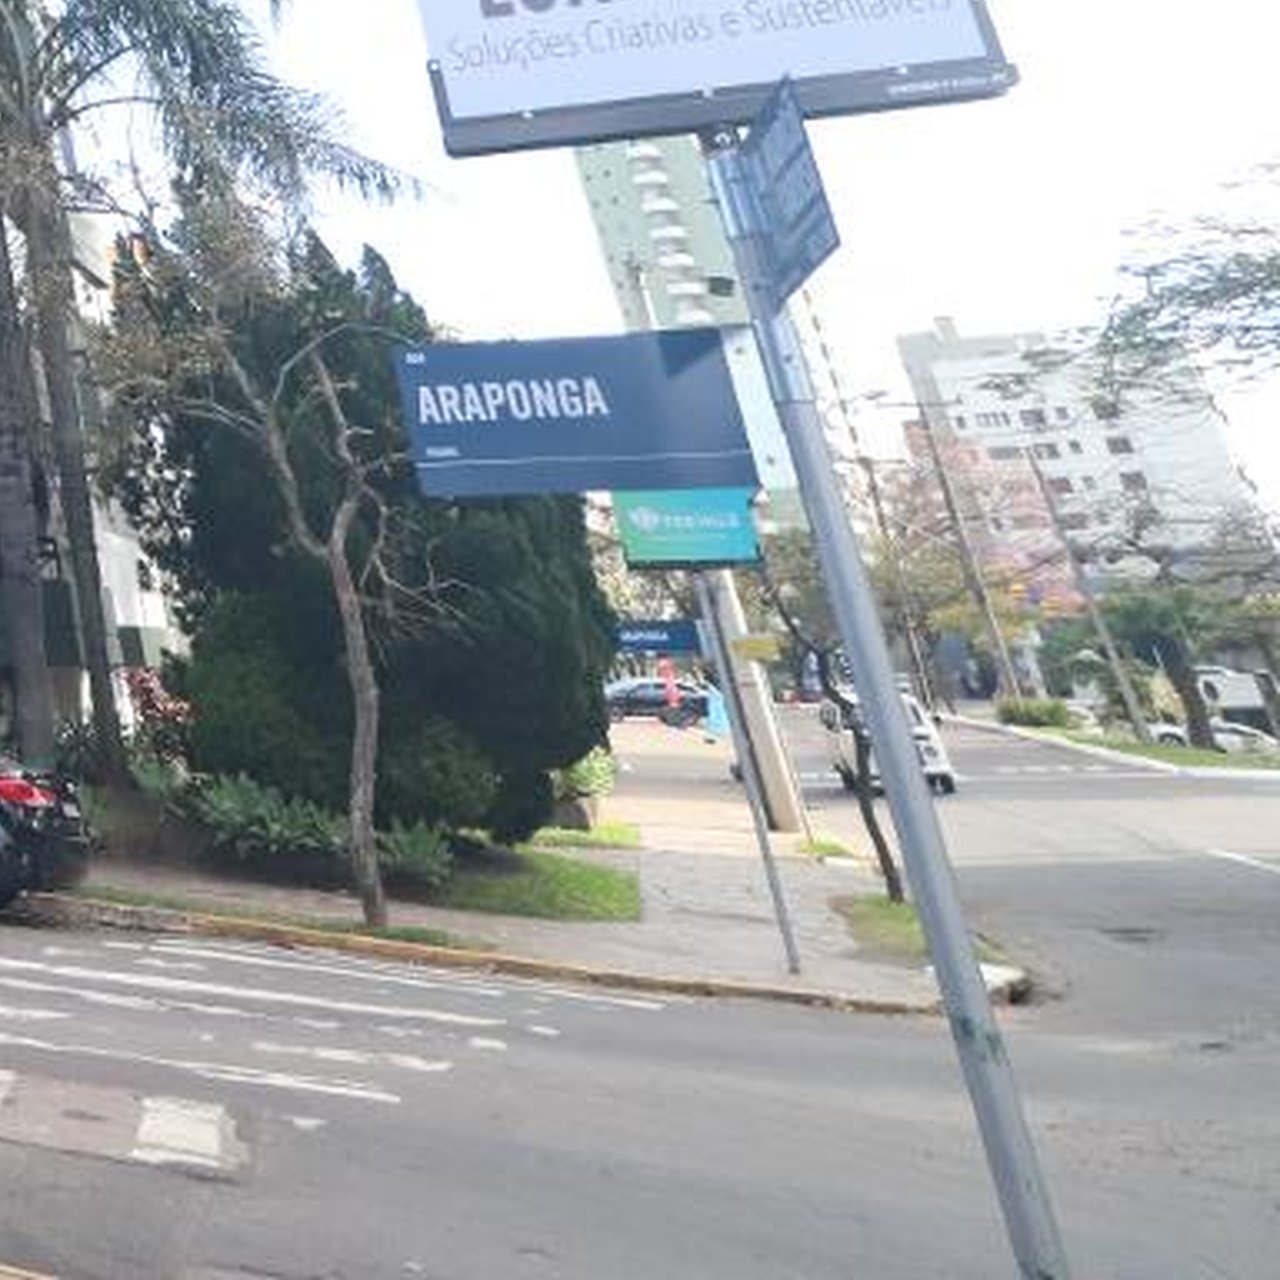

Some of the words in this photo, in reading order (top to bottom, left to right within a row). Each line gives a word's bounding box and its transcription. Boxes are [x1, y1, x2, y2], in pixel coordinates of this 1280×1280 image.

[448, 30, 578, 72] Soluções
[585, 16, 713, 53] Criativas
[719, 11, 741, 36] e
[418, 376, 610, 426] ARAPONGA
